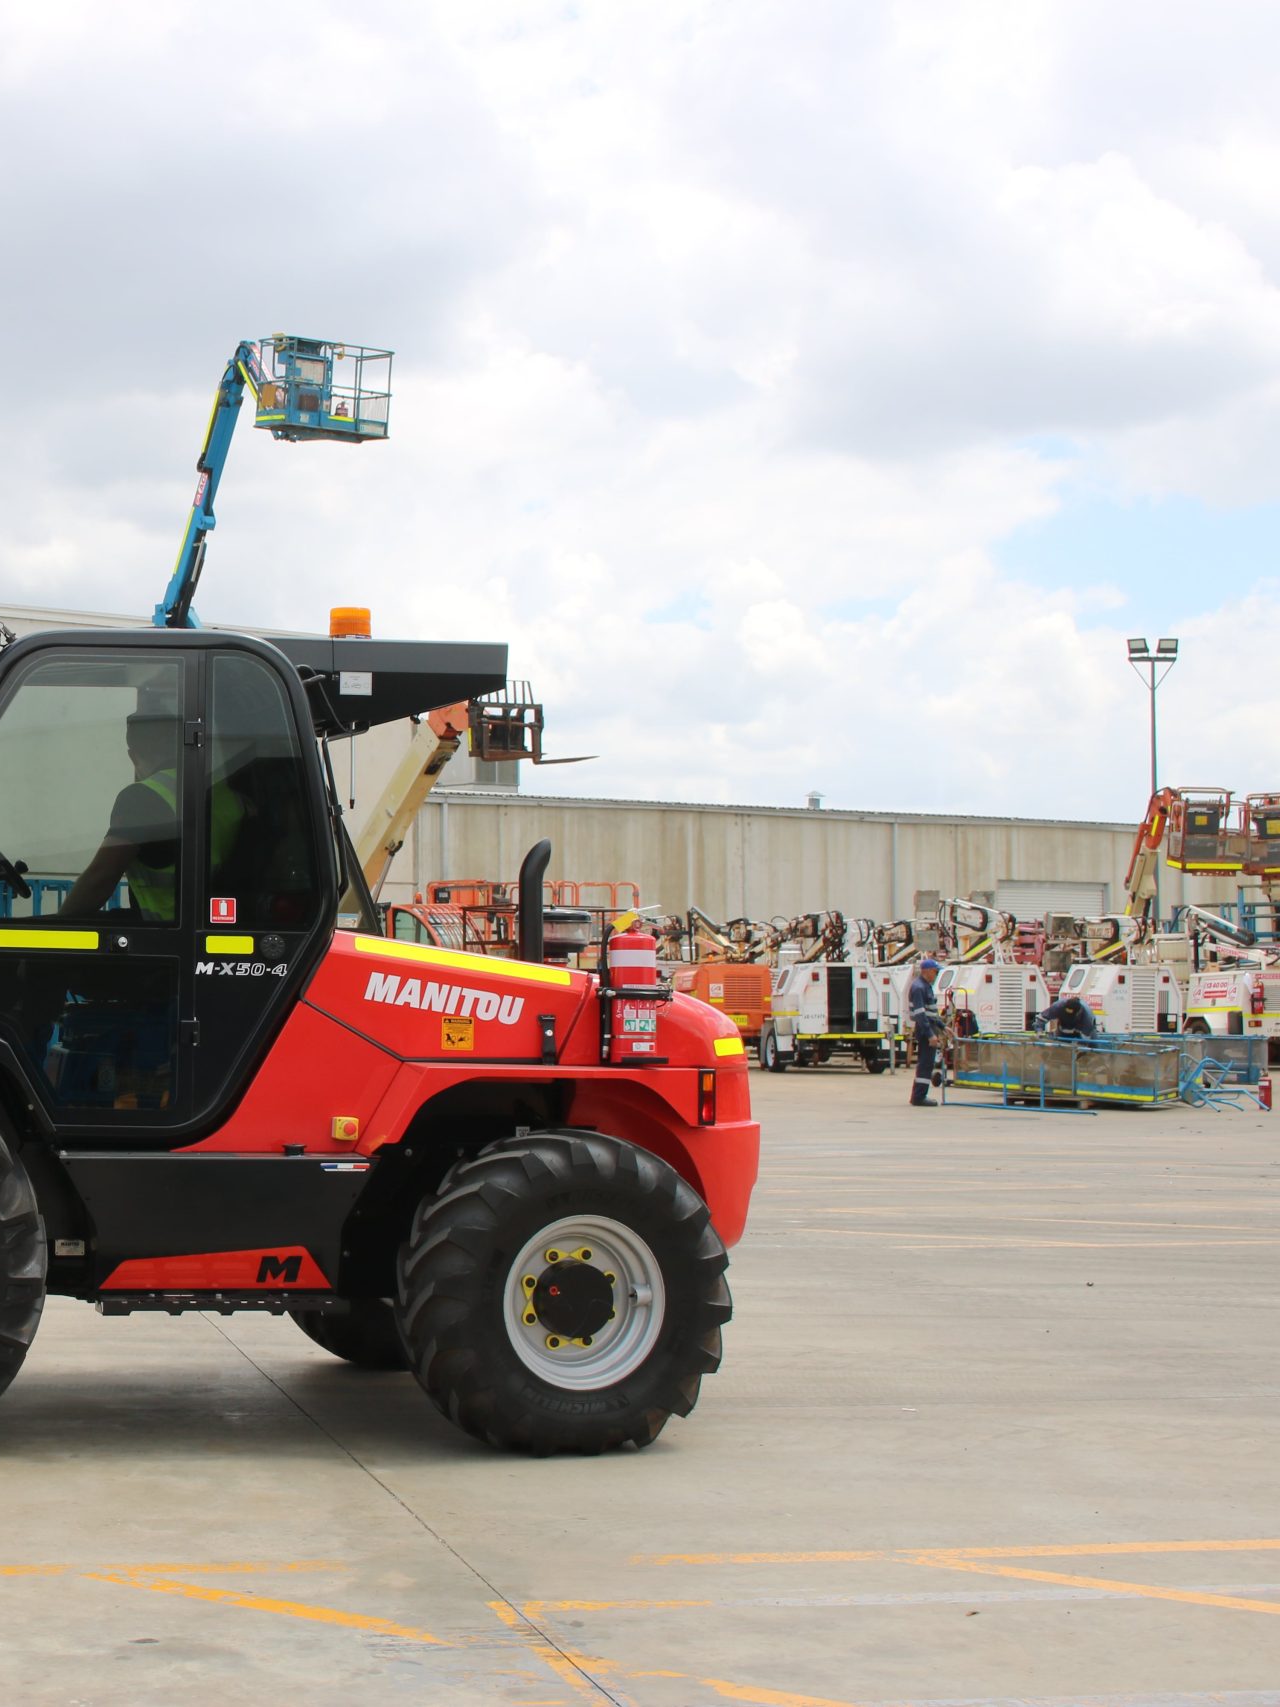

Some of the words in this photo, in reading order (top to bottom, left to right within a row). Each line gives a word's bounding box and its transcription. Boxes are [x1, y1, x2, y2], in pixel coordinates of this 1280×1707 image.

[195, 962, 287, 977] M-X50-4
[364, 972, 525, 1025] MANITOU
[256, 1256, 302, 1283] M
[520, 1386, 608, 1415] MICHELIN
